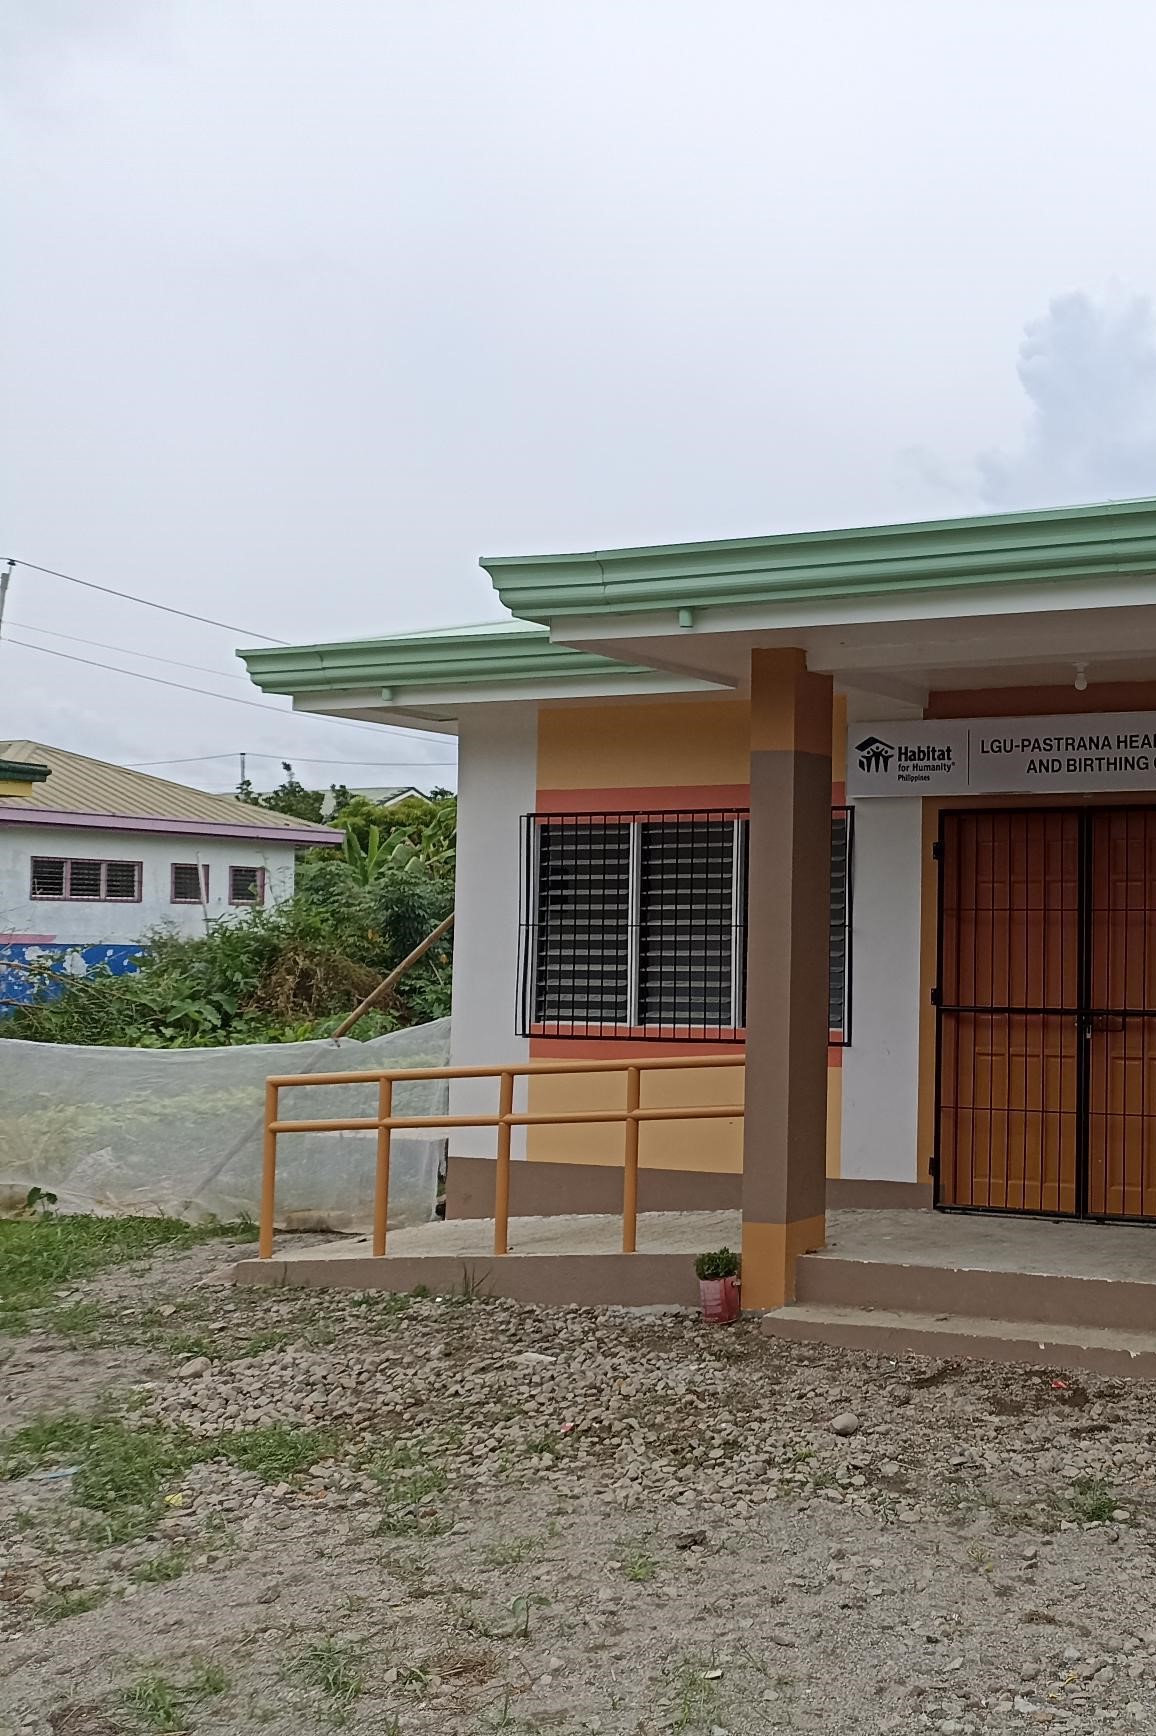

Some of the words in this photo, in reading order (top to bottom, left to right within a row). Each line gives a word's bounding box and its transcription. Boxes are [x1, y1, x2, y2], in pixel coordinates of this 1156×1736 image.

[980, 735, 1112, 754] LGU-PASTRANA
[897, 745, 952, 762] Habitat
[897, 763, 910, 773] for
[1026, 757, 1063, 774] AND
[1066, 755, 1149, 773] BIRTHING
[897, 774, 931, 783] Philippines
